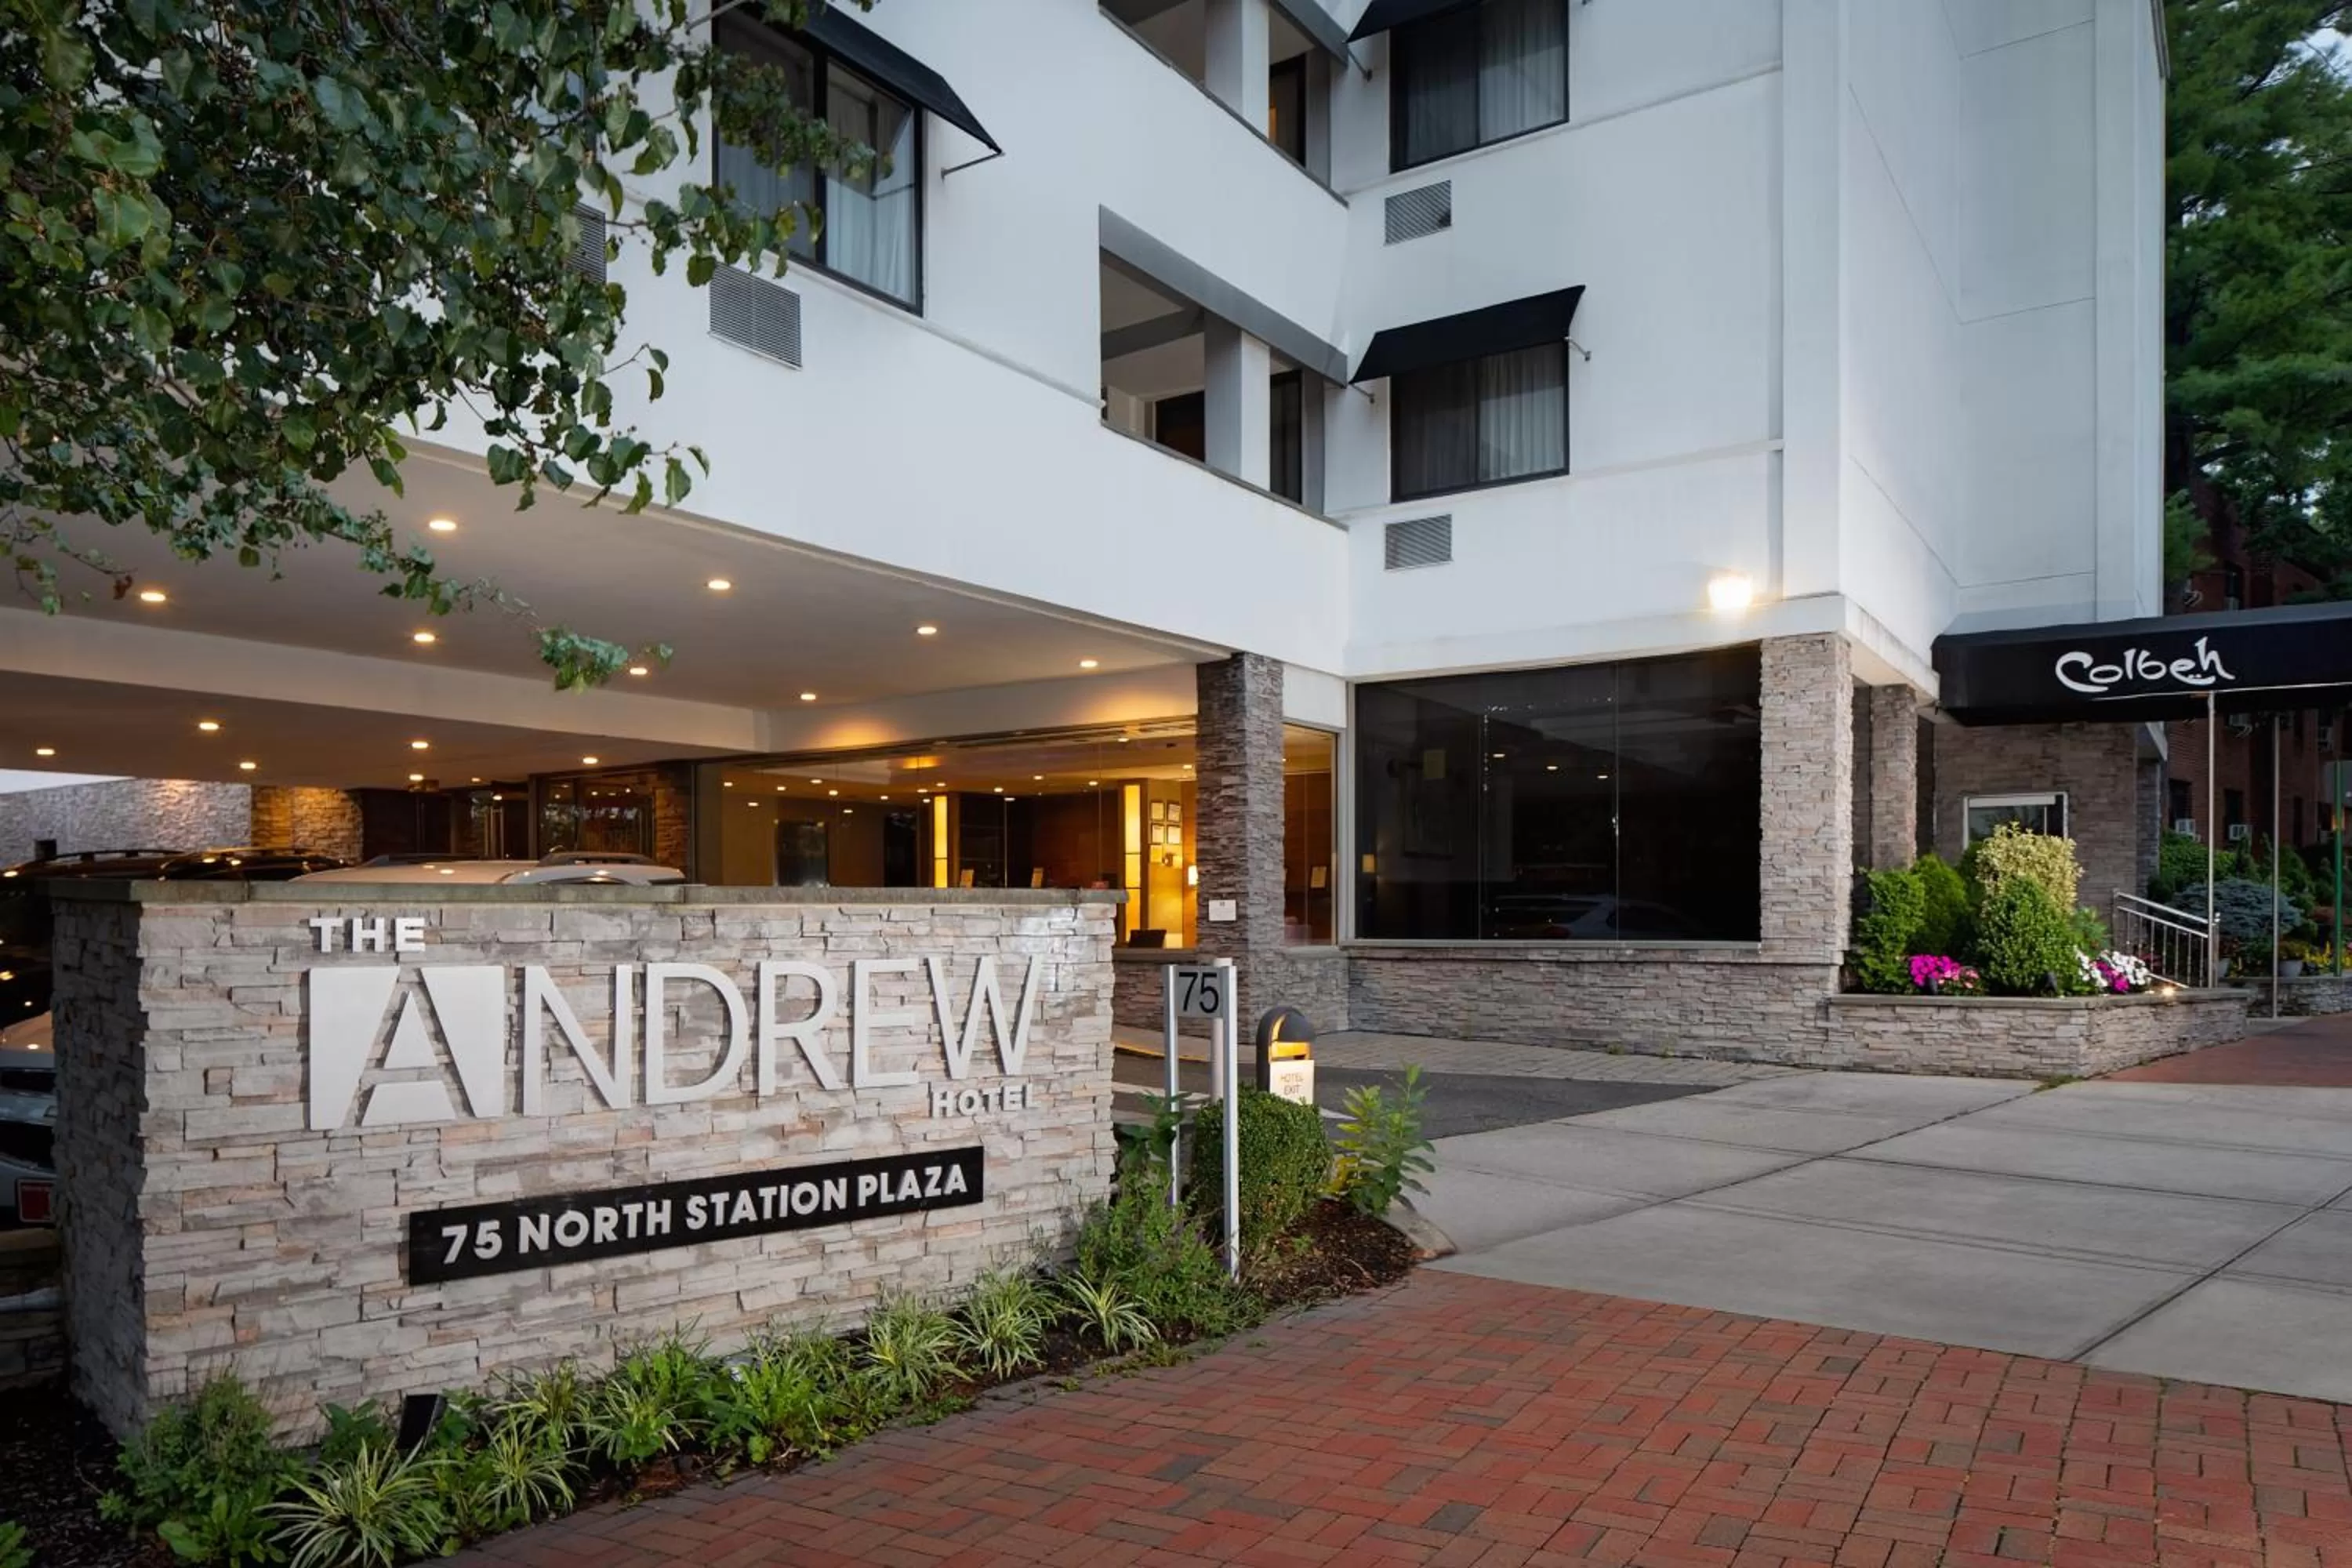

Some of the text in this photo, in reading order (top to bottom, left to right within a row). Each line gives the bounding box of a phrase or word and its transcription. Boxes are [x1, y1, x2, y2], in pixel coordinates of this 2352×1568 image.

[2055, 636, 2235, 693] Colbeh
[309, 916, 426, 953] THE
[1178, 971, 1219, 1014] 75
[309, 953, 1042, 1131] ANDREW
[932, 1083, 1041, 1117] HOTEL
[441, 1164, 967, 1265] 75 NORTH STATION PLAZA
